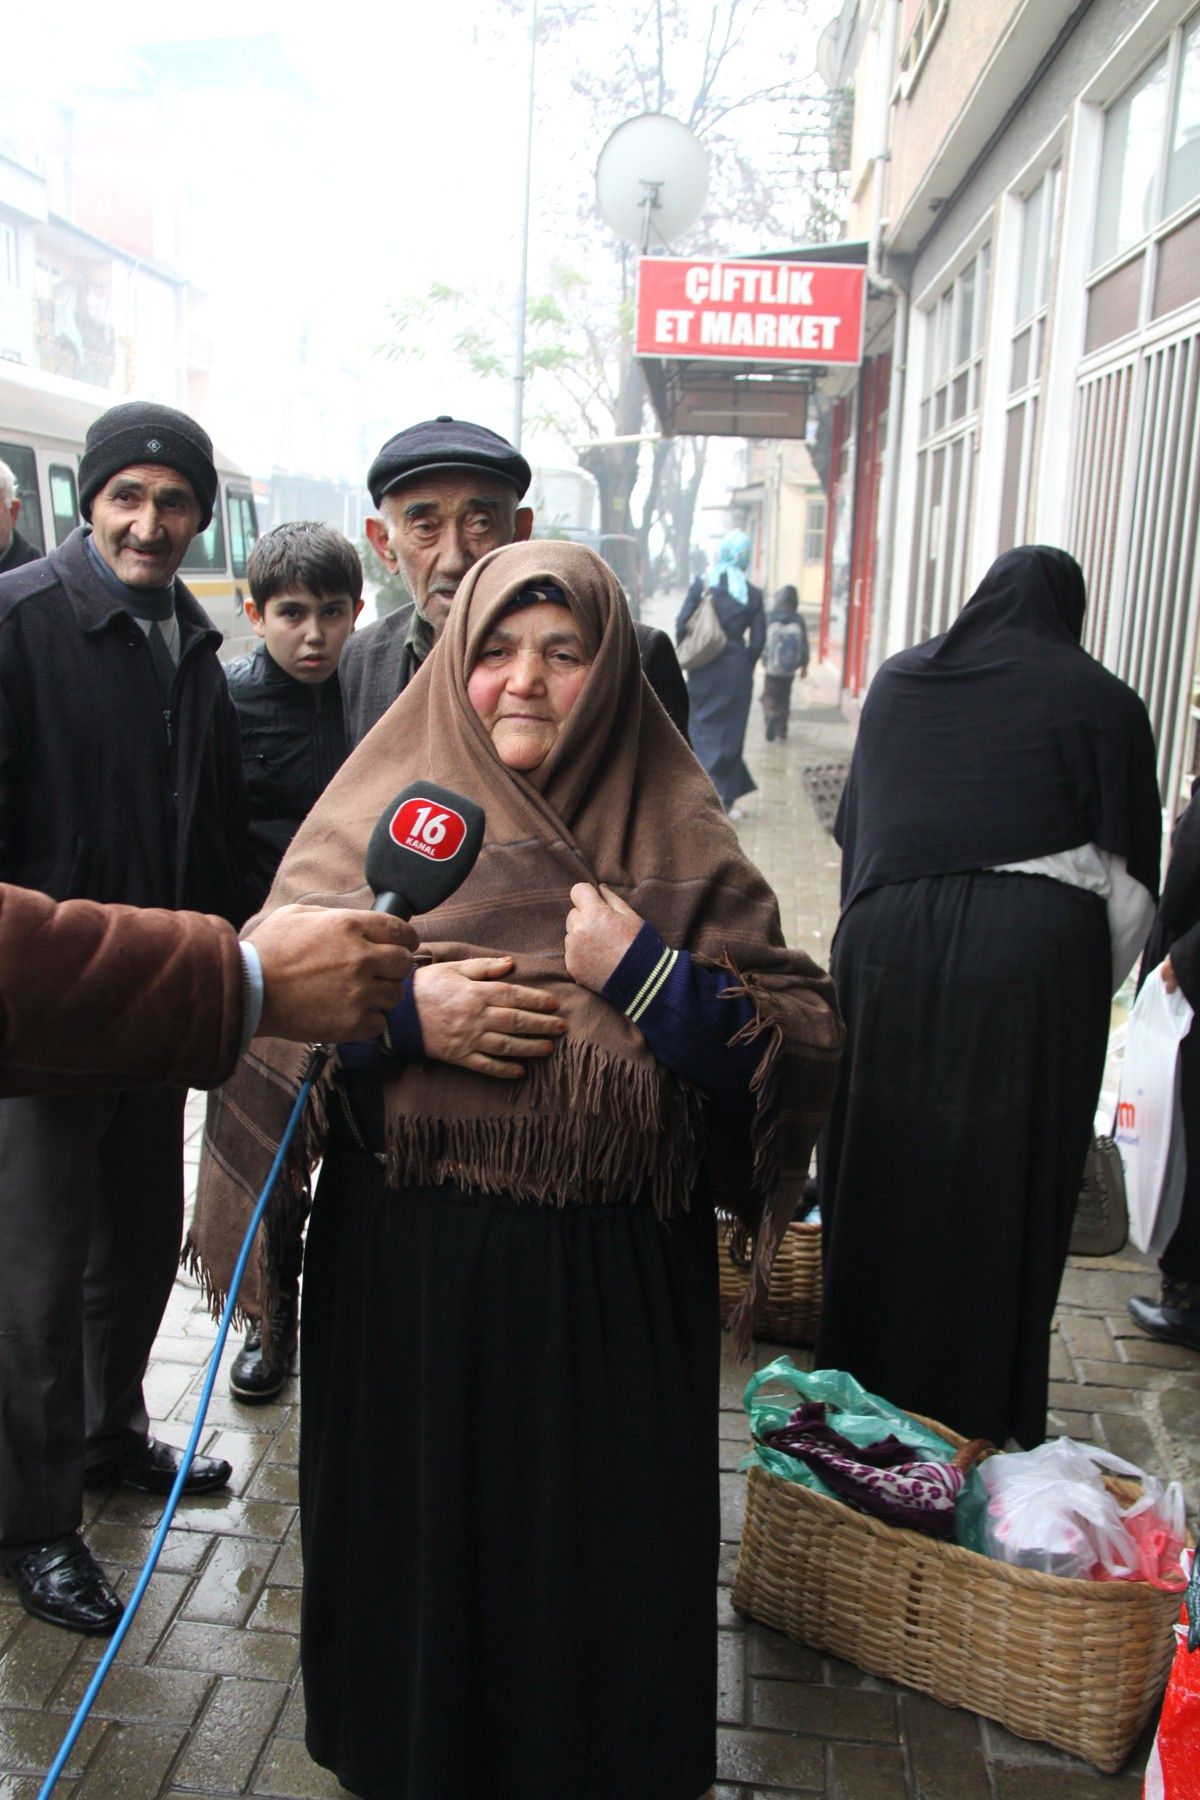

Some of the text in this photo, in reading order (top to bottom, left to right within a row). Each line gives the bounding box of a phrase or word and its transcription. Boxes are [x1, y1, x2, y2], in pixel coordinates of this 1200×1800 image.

[685, 264, 814, 304] ÇİFTLİK
[655, 309, 841, 350] ET MARKET
[409, 807, 450, 845] 16
[405, 837, 436, 856] KANAL
